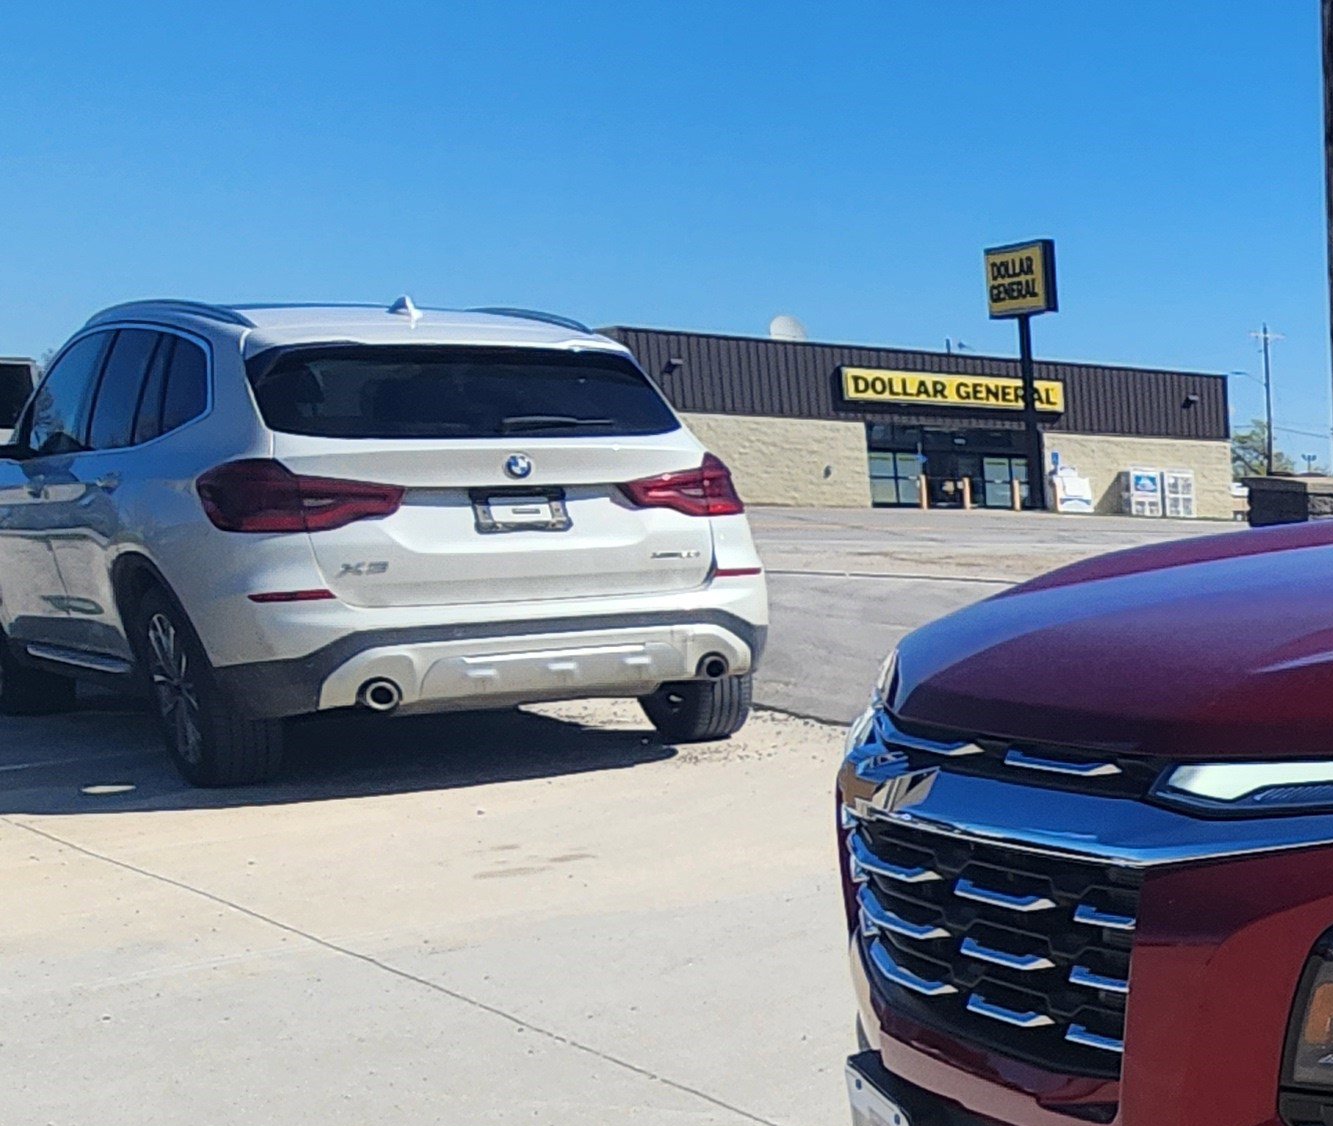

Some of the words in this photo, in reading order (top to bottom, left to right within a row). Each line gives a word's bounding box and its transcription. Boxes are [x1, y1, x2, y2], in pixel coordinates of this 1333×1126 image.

[990, 256, 1034, 281] DOLLAR
[990, 279, 1039, 303] GENERAL
[852, 375, 948, 399] DOLLAR
